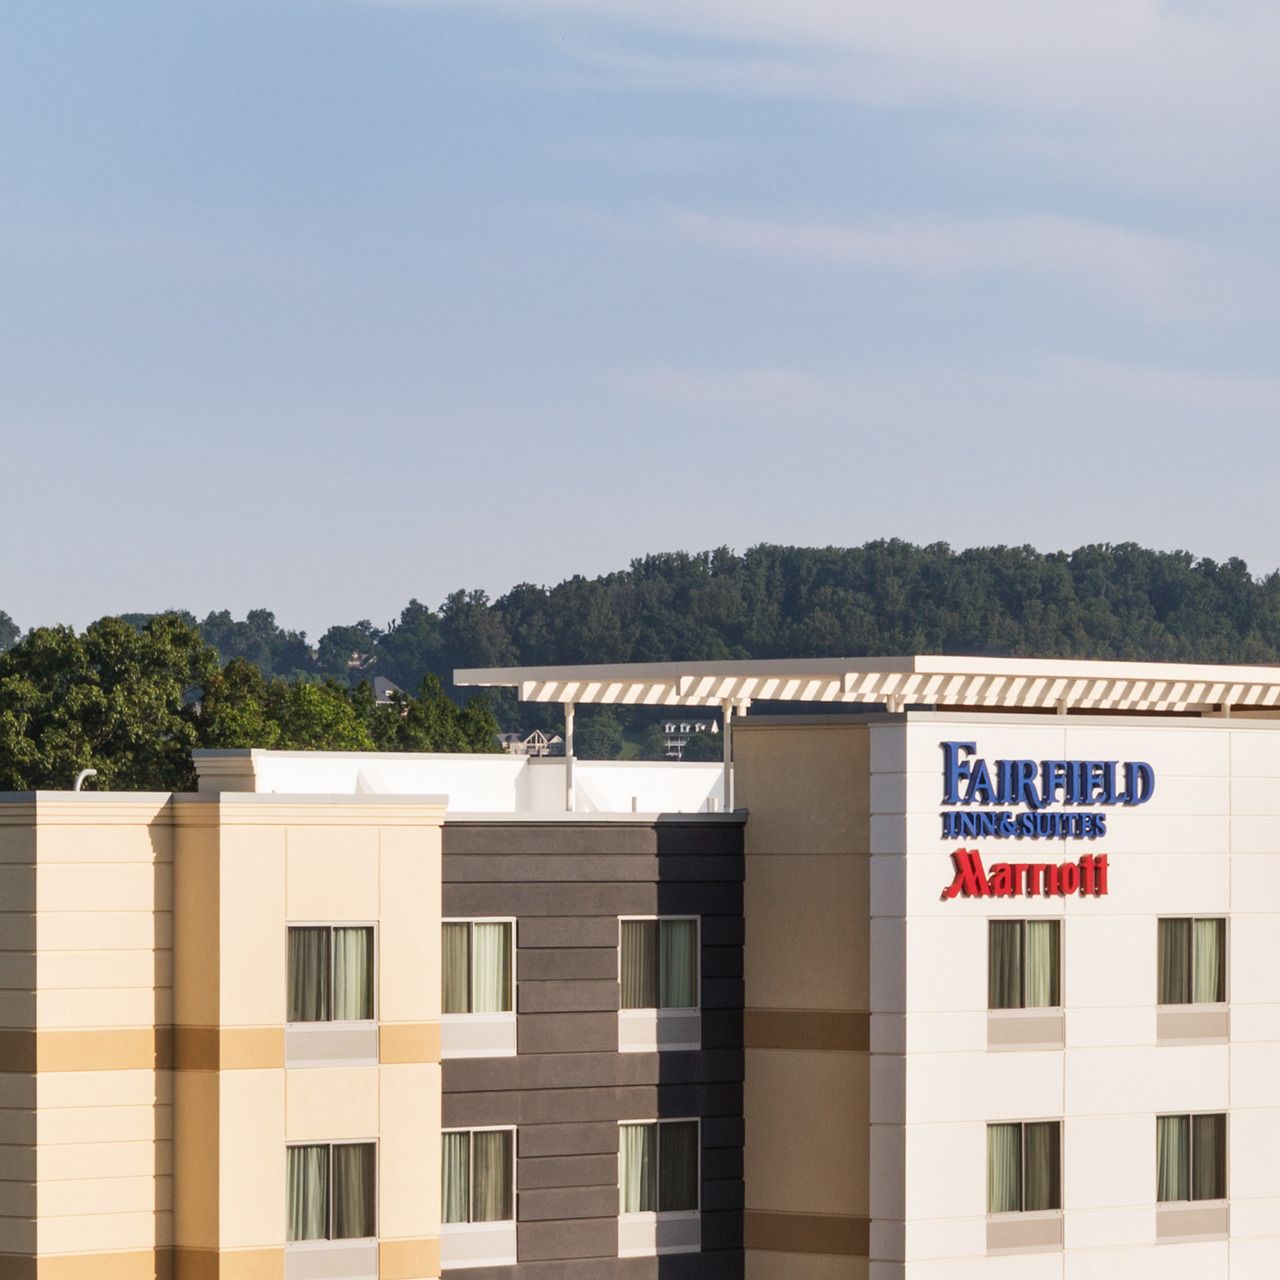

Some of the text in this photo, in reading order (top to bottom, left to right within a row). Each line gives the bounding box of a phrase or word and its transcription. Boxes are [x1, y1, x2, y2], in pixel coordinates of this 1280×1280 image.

[939, 741, 1156, 810] FAIRFIELD
[939, 810, 1108, 840] INN & SUITES
[940, 847, 1110, 900] Marriott
